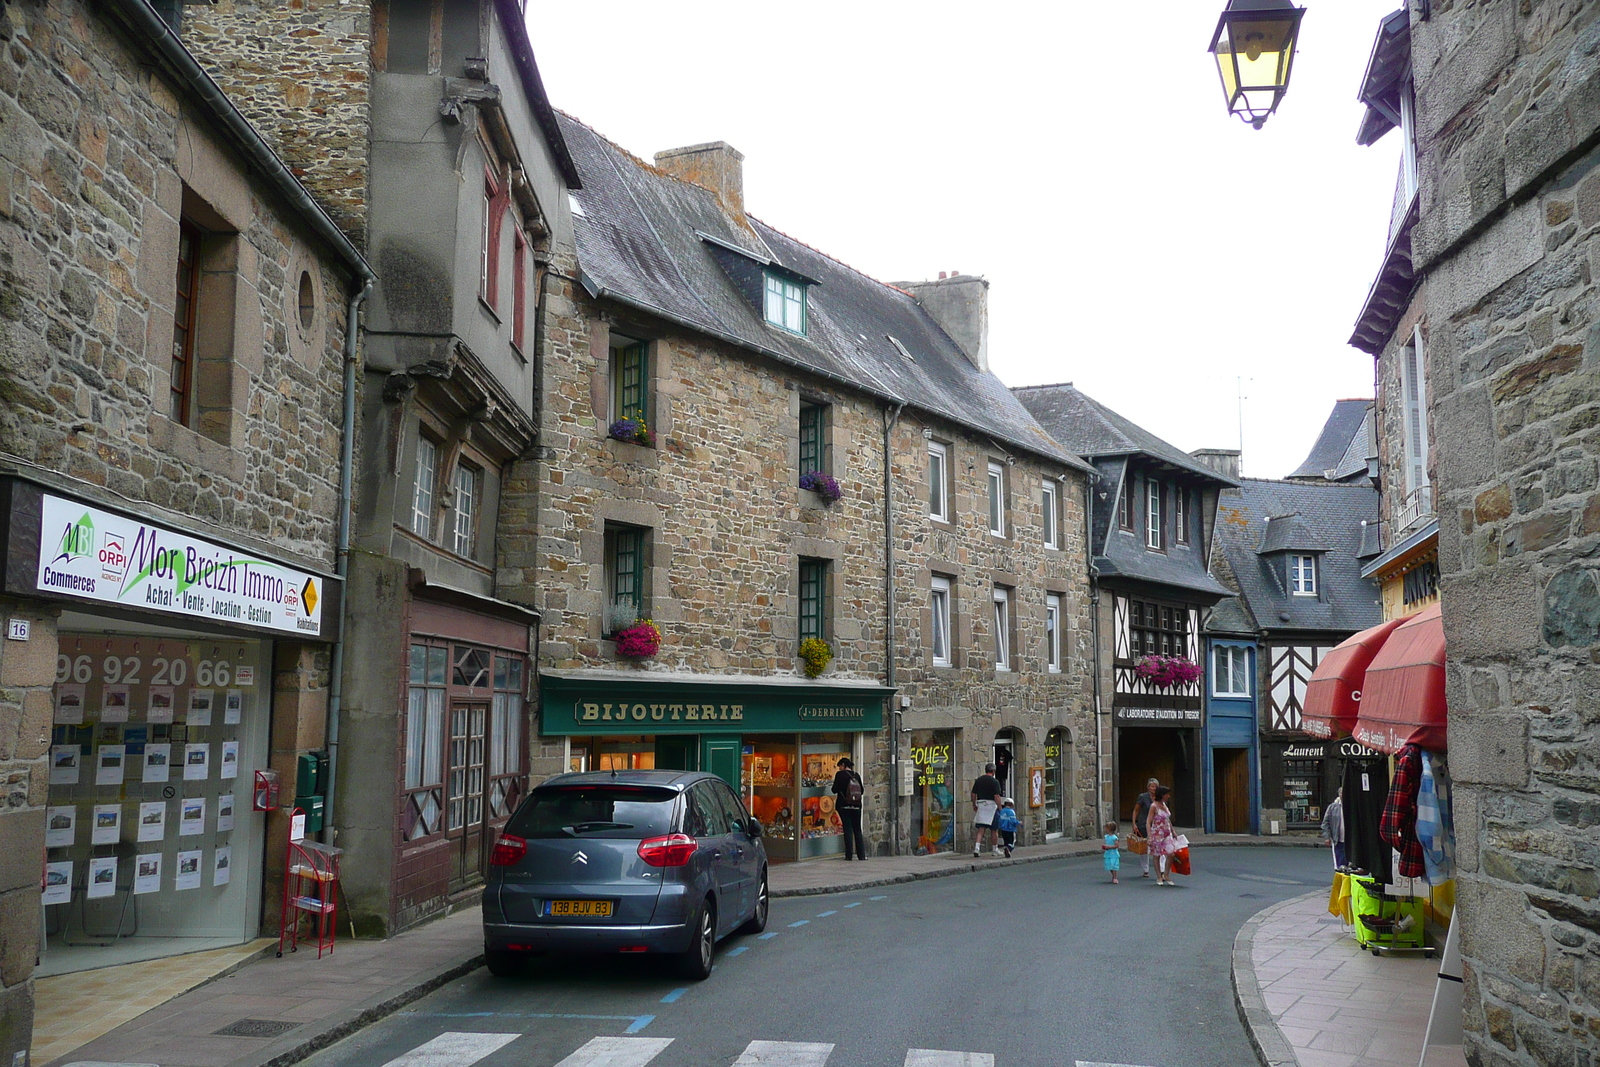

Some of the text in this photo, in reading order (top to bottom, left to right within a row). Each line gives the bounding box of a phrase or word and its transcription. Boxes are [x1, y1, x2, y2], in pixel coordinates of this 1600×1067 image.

[99, 549, 126, 568] ORPI
[117, 526, 283, 604] Mor Breizh Immo
[44, 566, 96, 593] Commerces
[146, 584, 172, 606] Achat
[183, 590, 204, 611] Vente
[211, 596, 241, 618] Location
[247, 604, 272, 624] Gestion
[284, 595, 298, 606] ORPI
[13, 624, 26, 636] 16
[56, 654, 230, 687] 96 92 20 66
[582, 703, 743, 721] BIJOUTERIE
[1126, 709, 1155, 719] LABORATOIRE
[1155, 709, 1177, 720] D'AUDITION
[1177, 710, 1184, 719] DU
[1283, 744, 1324, 757] Laurent
[926, 765, 934, 775] du
[919, 774, 945, 786] 36 au 58
[553, 902, 608, 914] 138 BJV 83
